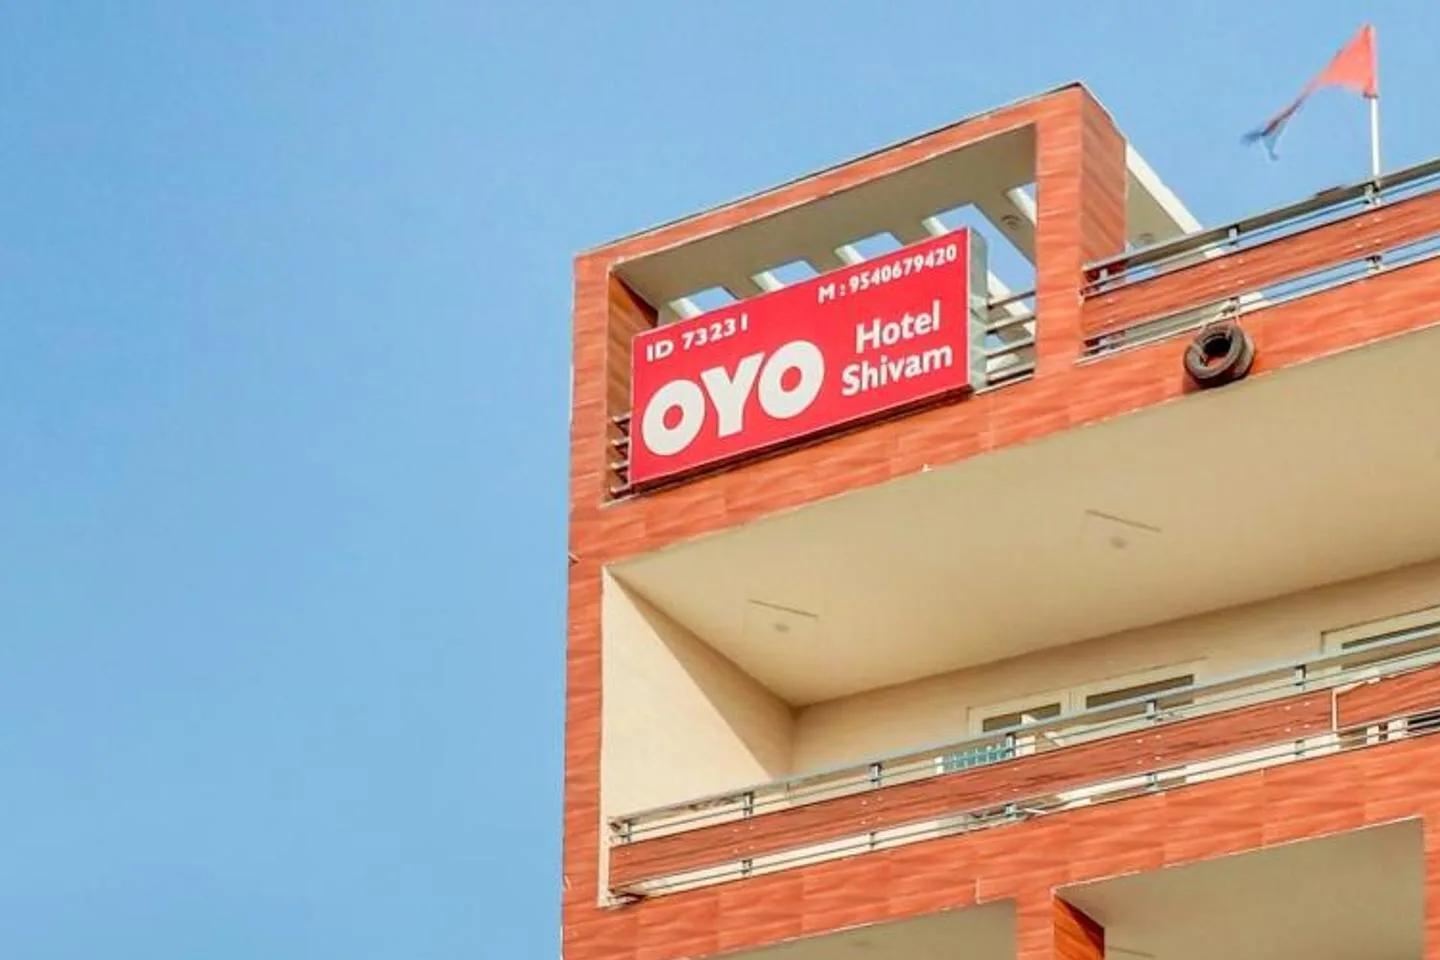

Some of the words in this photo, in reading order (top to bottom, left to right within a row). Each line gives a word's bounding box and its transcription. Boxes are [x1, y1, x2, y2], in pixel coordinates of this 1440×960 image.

[646, 343, 674, 362] ID
[681, 314, 748, 350] 73231
[855, 300, 941, 353] Hotel
[841, 346, 953, 397] Shivam
[641, 340, 825, 456] OYO
